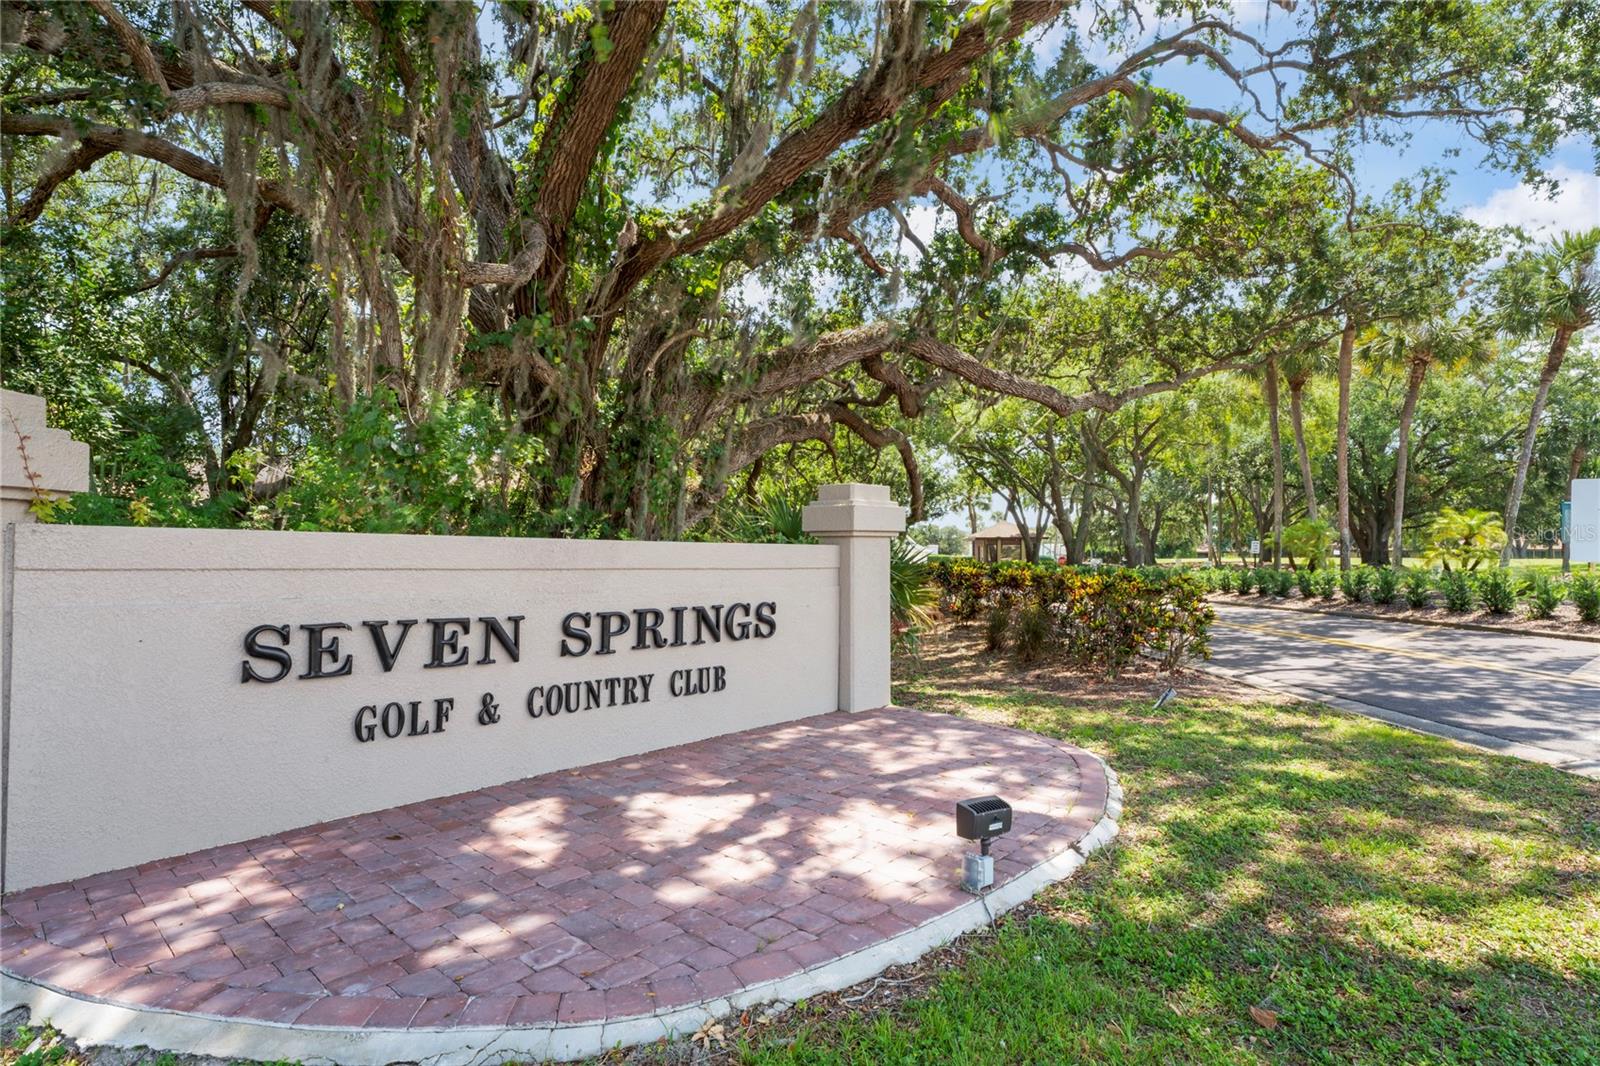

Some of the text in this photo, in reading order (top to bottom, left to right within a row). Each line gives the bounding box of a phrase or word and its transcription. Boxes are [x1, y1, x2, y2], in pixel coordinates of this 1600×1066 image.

[241, 601, 777, 684] SEVEN SPRINGS
[354, 665, 727, 743] GOLF & COUNTRY CLUB
